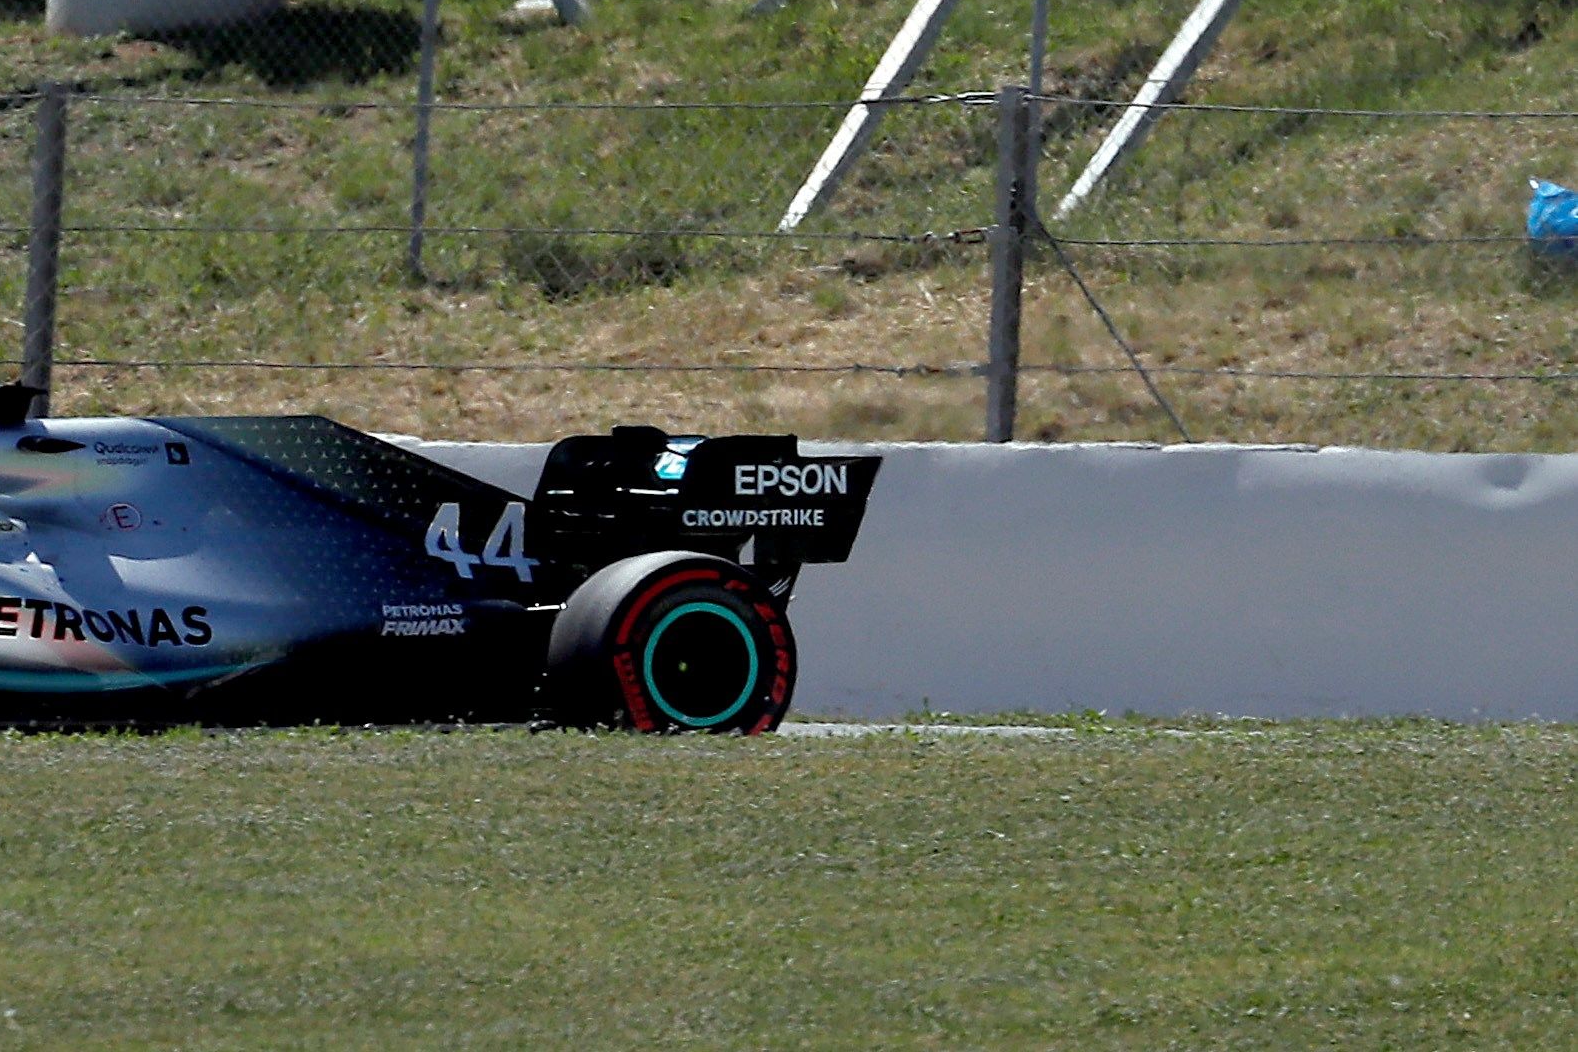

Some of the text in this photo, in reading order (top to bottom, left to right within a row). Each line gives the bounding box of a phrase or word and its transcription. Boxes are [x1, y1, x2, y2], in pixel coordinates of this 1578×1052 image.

[735, 463, 847, 496] EPSON
[682, 509, 825, 527] CROWDSTRIKE
[424, 501, 541, 582] 44
[382, 603, 463, 616] PETRONAS
[381, 618, 466, 636] FRIMAX
